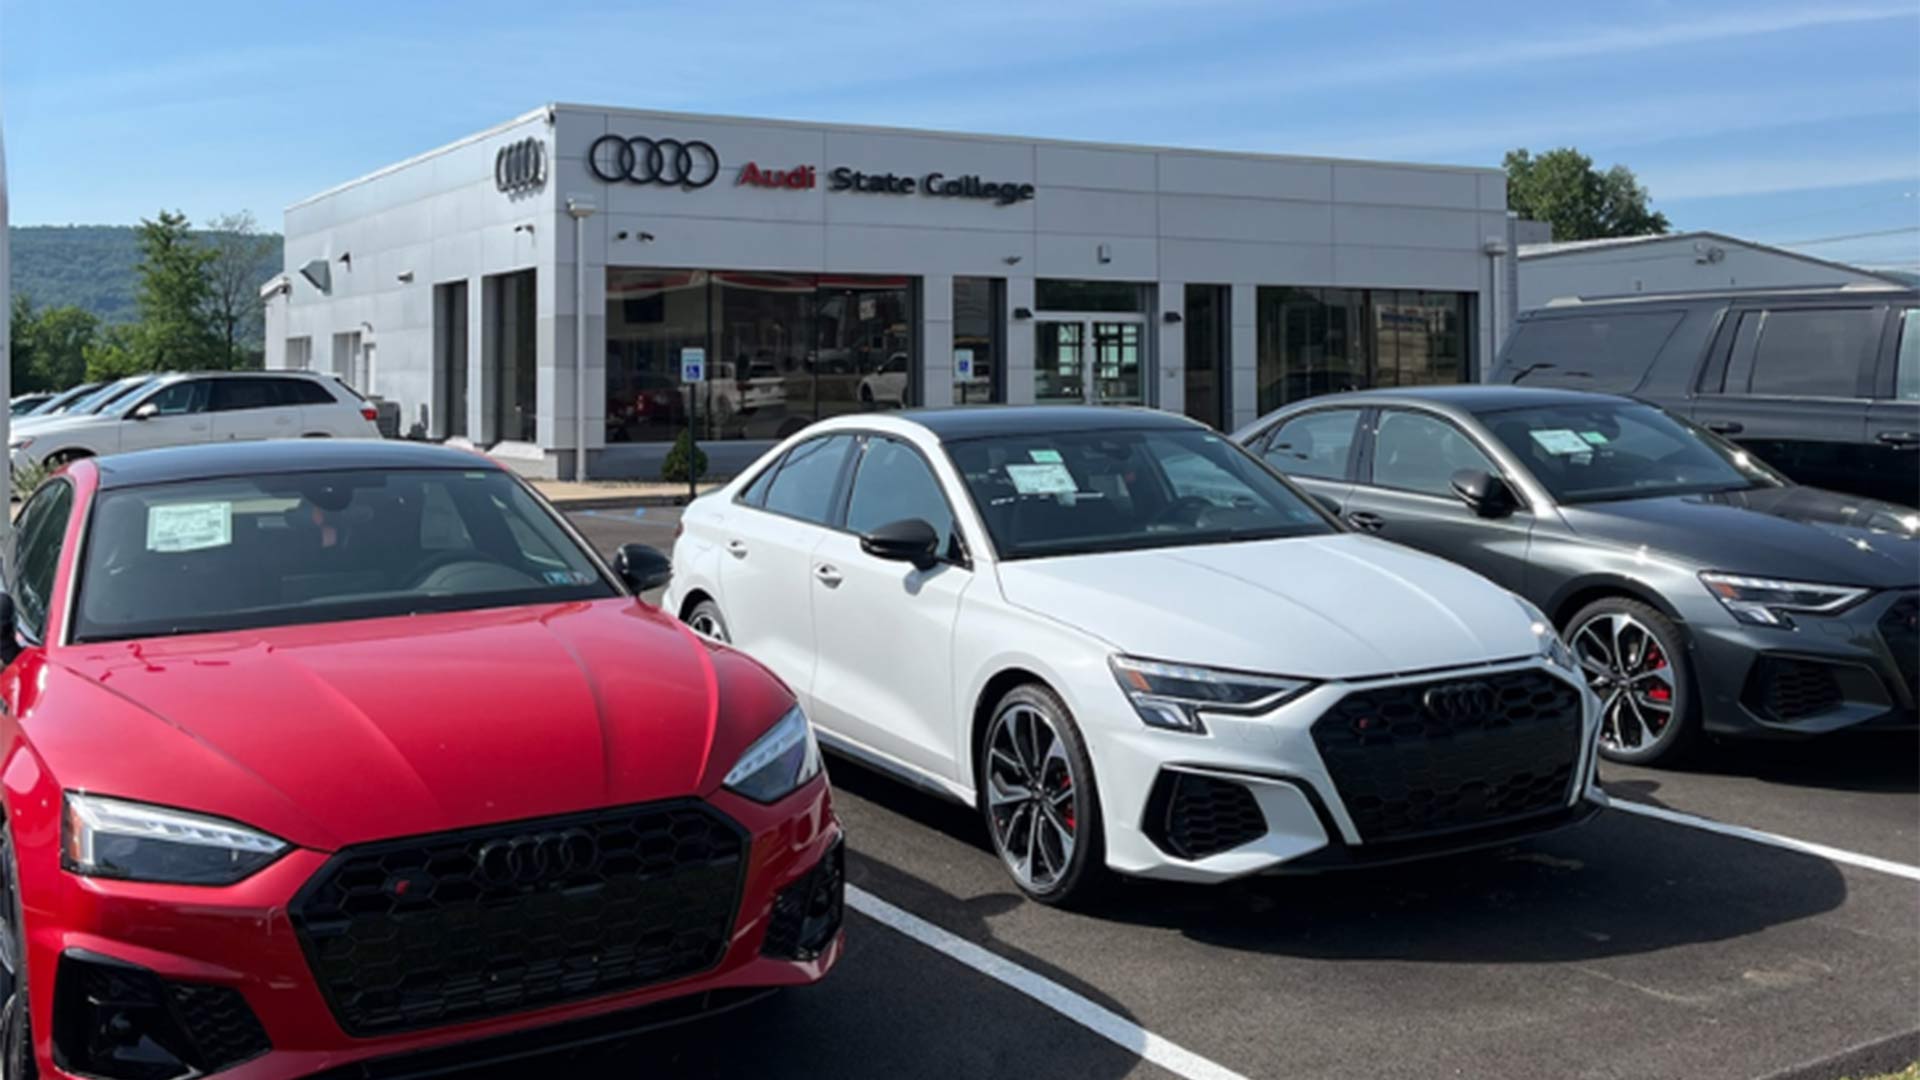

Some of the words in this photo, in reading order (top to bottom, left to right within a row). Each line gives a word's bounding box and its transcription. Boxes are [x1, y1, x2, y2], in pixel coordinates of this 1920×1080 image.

[738, 161, 816, 190] Audi
[831, 167, 916, 194] State
[924, 173, 1035, 206] College
